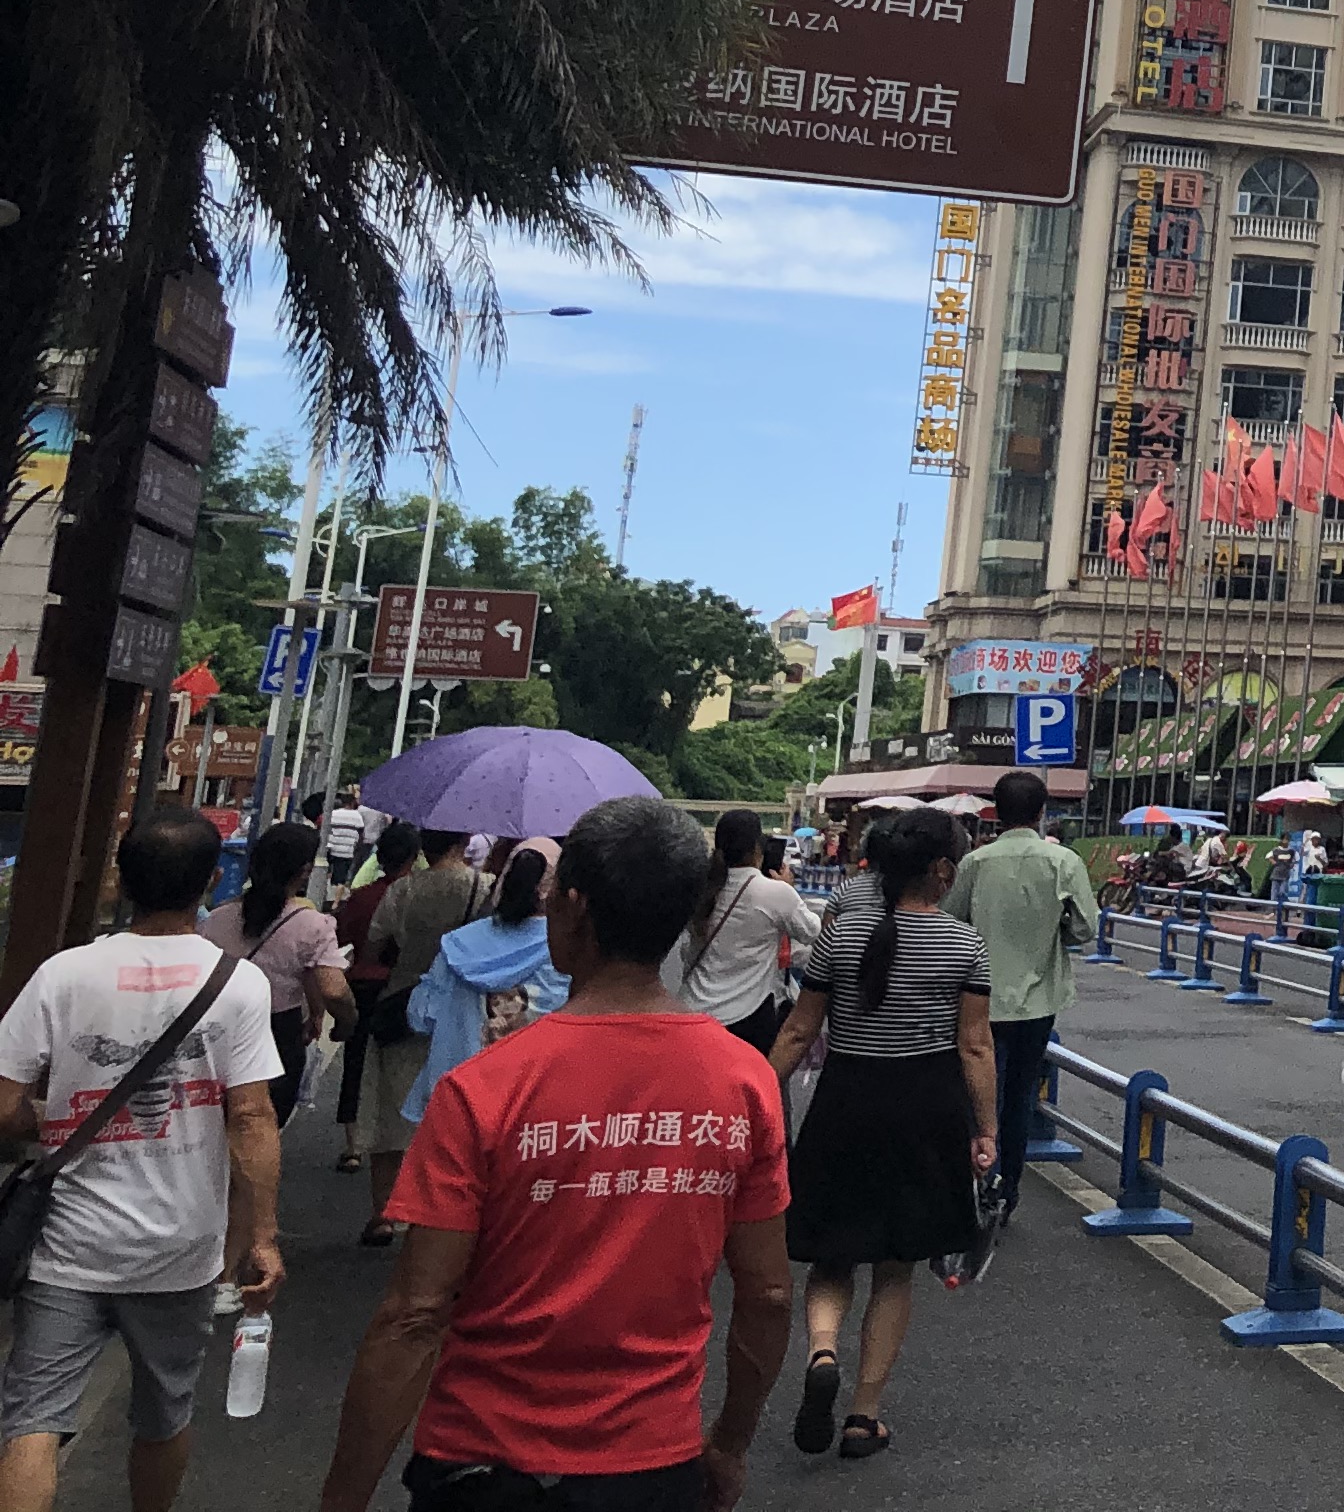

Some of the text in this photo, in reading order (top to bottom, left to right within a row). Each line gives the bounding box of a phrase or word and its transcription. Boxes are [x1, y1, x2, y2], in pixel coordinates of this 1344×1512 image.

[880, 129, 959, 156] HOTEL
[1029, 699, 1067, 742] P
[516, 1109, 752, 1162] 桐木顺通农资
